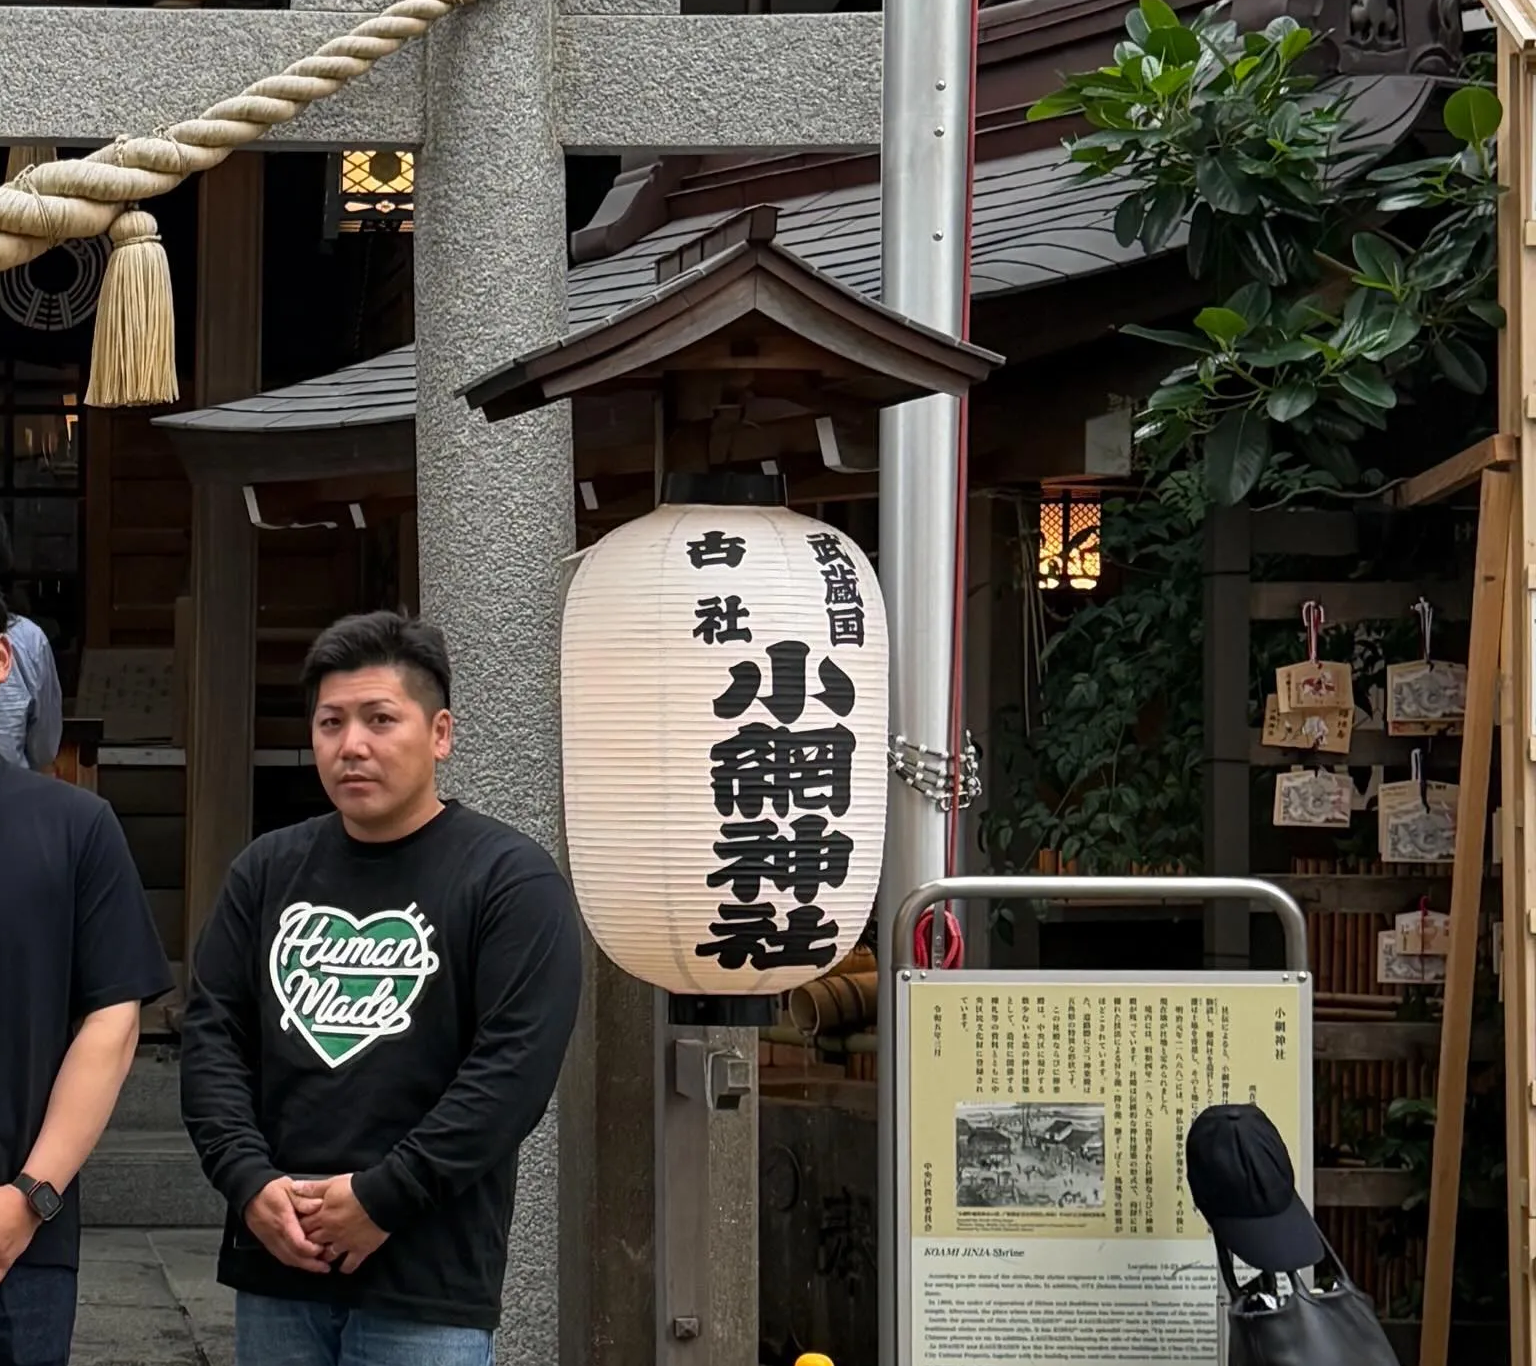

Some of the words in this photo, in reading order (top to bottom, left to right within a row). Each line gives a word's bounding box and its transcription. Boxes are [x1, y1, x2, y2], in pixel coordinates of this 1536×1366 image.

[685, 529, 753, 645] 古社
[805, 531, 866, 648] 武蔵国
[695, 639, 858, 972] 小網神社
[278, 901, 439, 975] Human
[279, 968, 411, 1036] Made
[1274, 1006, 1287, 1060] 小網神社
[924, 1247, 959, 1258] KOAMI
[961, 1247, 990, 1258] JINJA
[992, 1247, 1025, 1258] Shrine
